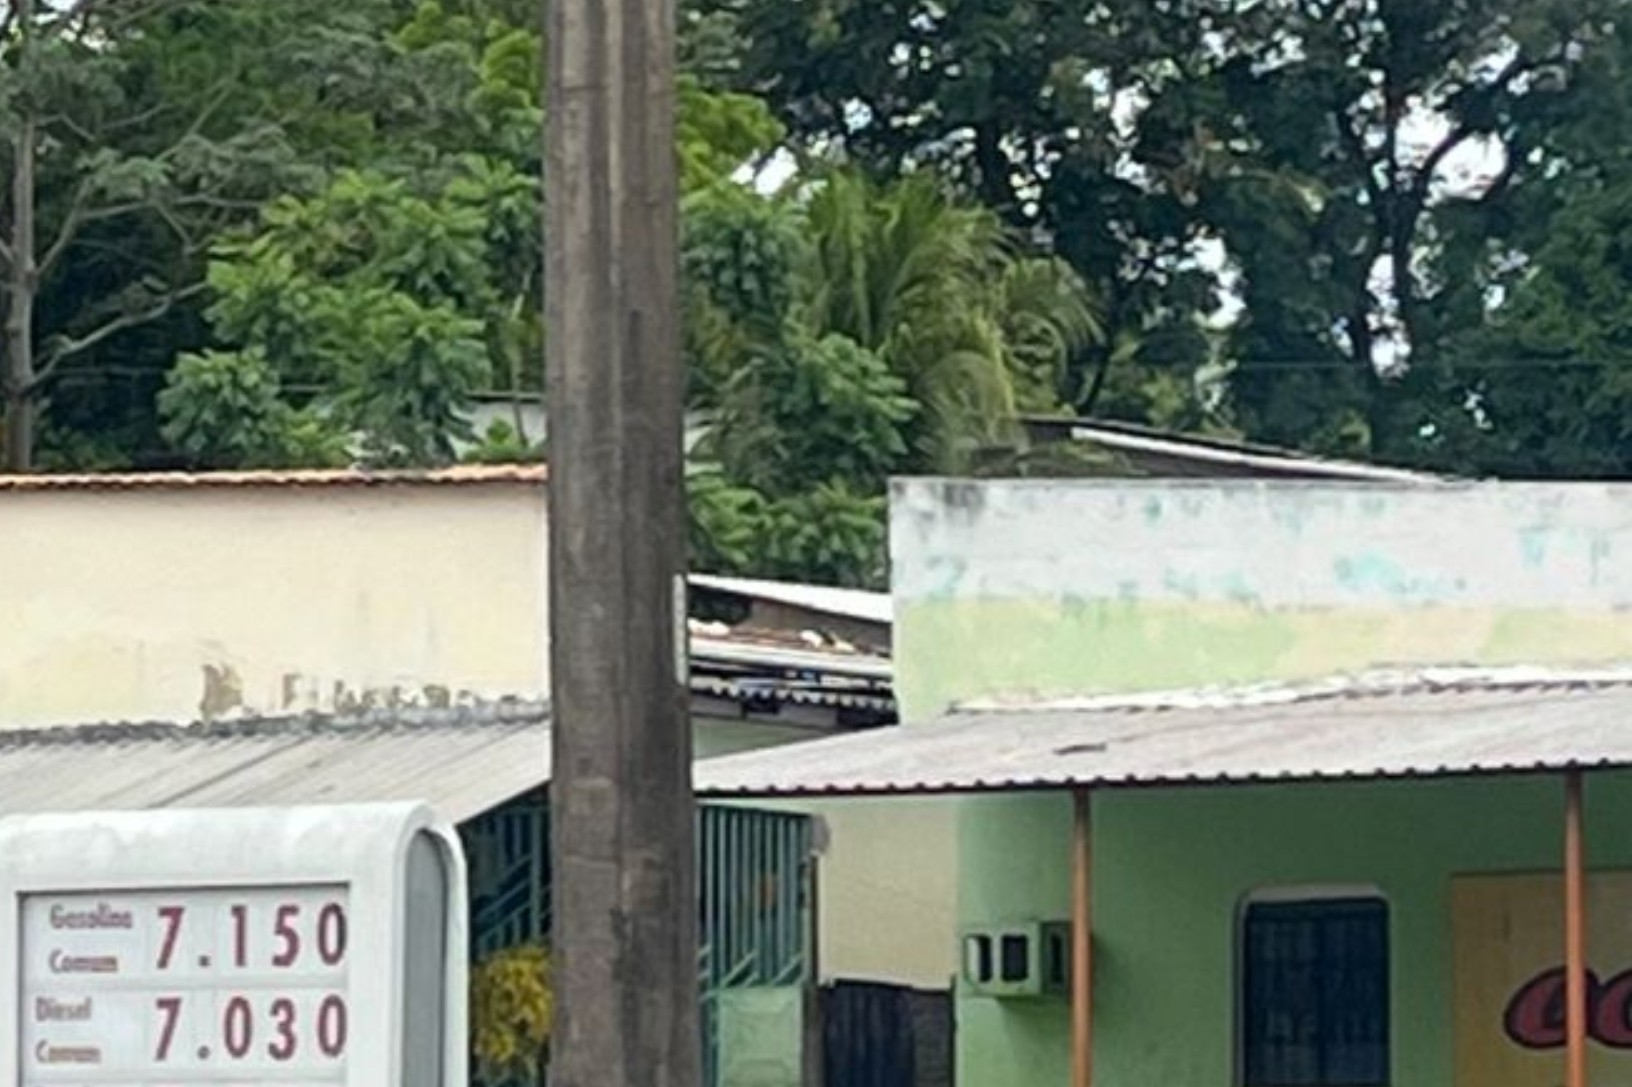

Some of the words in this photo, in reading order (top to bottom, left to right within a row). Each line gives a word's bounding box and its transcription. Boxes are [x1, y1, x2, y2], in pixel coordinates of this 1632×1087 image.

[49, 903, 133, 930] Gasolina
[156, 902, 348, 969] 7.150
[49, 949, 119, 973] Comum
[35, 997, 92, 1022] Diesel
[154, 995, 348, 1061] 7.030
